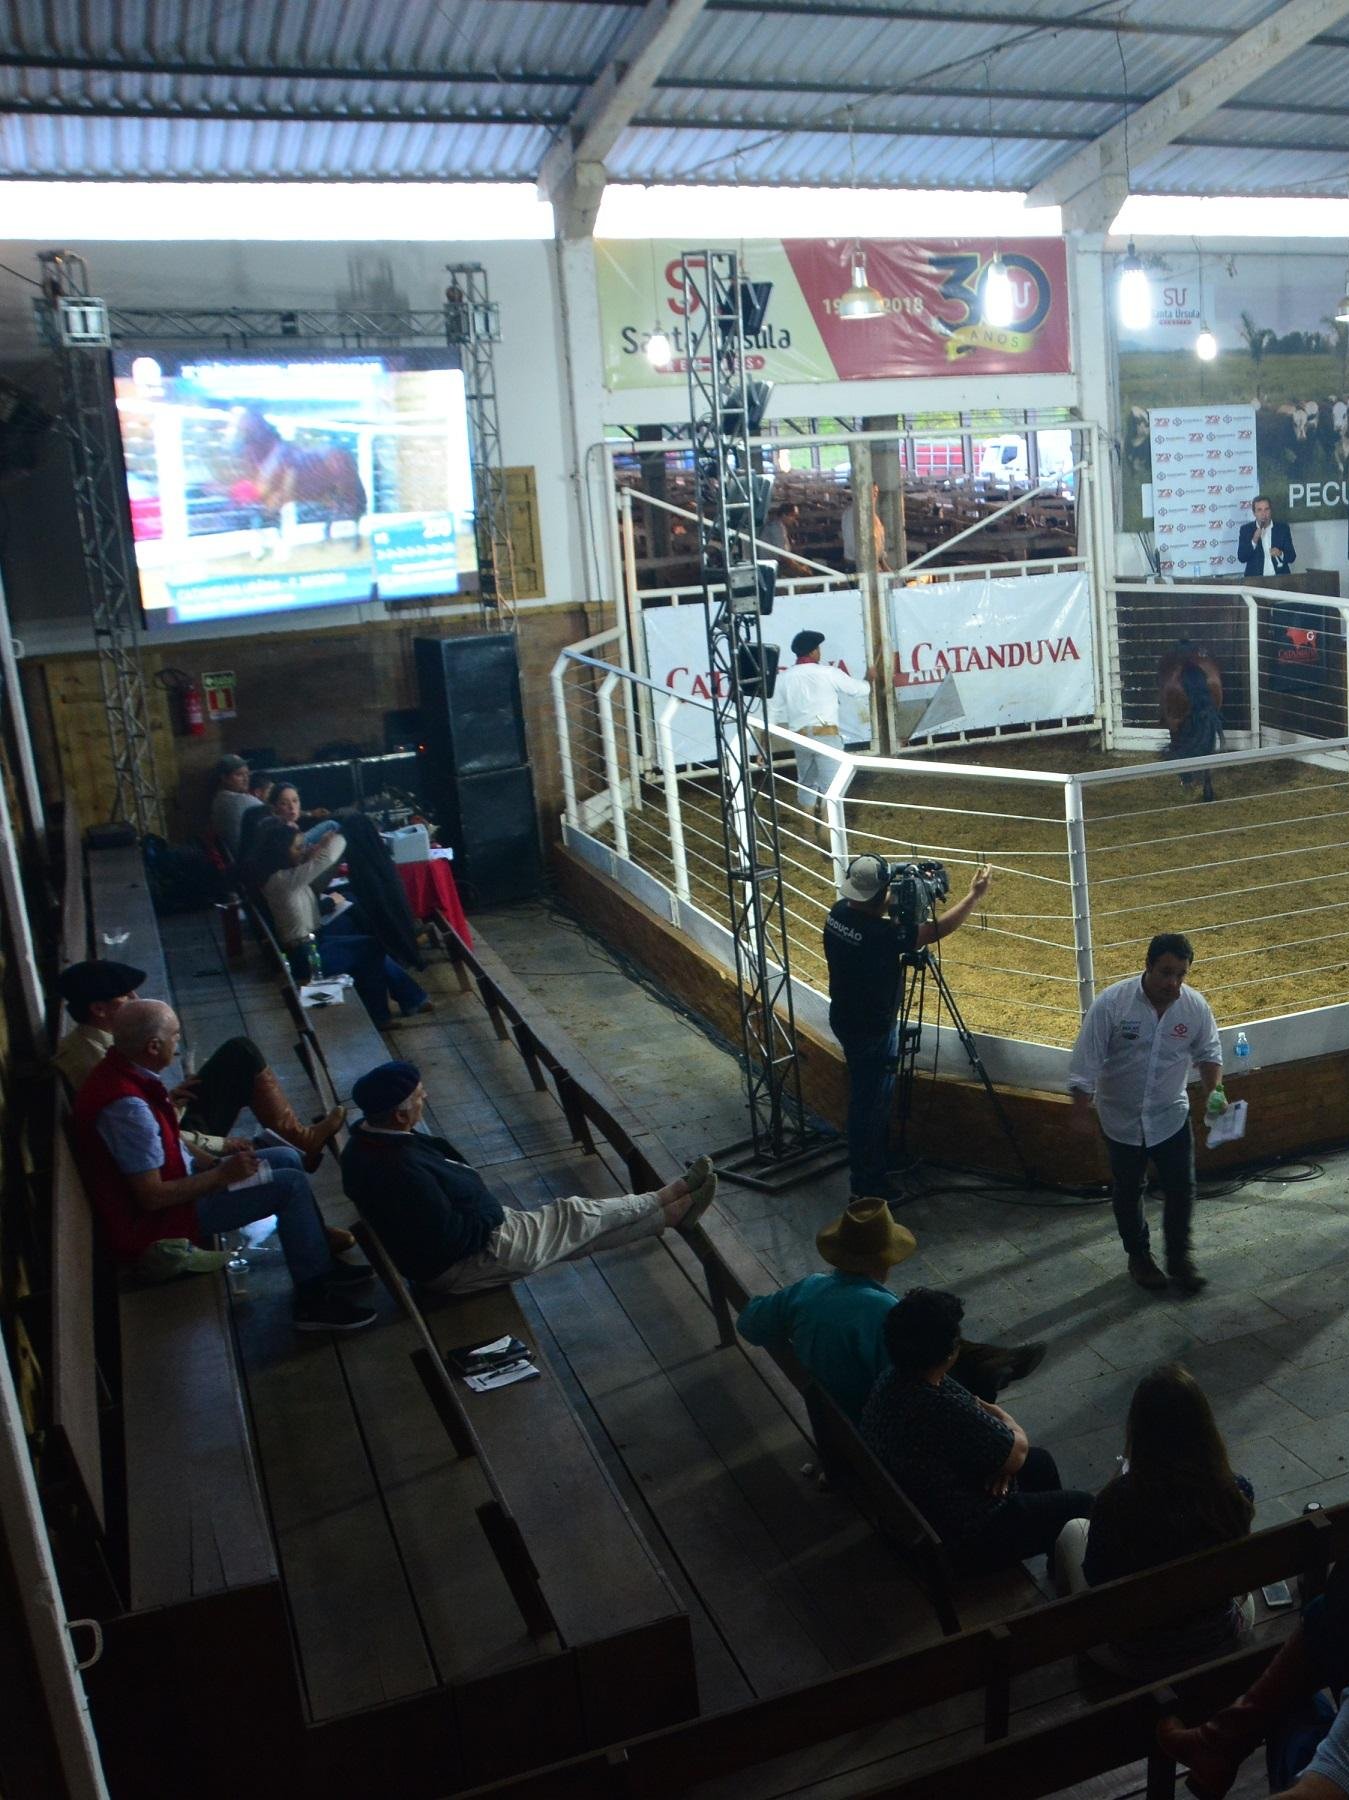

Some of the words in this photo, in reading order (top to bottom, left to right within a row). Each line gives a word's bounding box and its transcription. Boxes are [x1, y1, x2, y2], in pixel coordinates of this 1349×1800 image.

[1163, 287, 1187, 307] SU
[970, 328, 1020, 348] ANOS
[911, 636, 1081, 674] CATANDUVA
